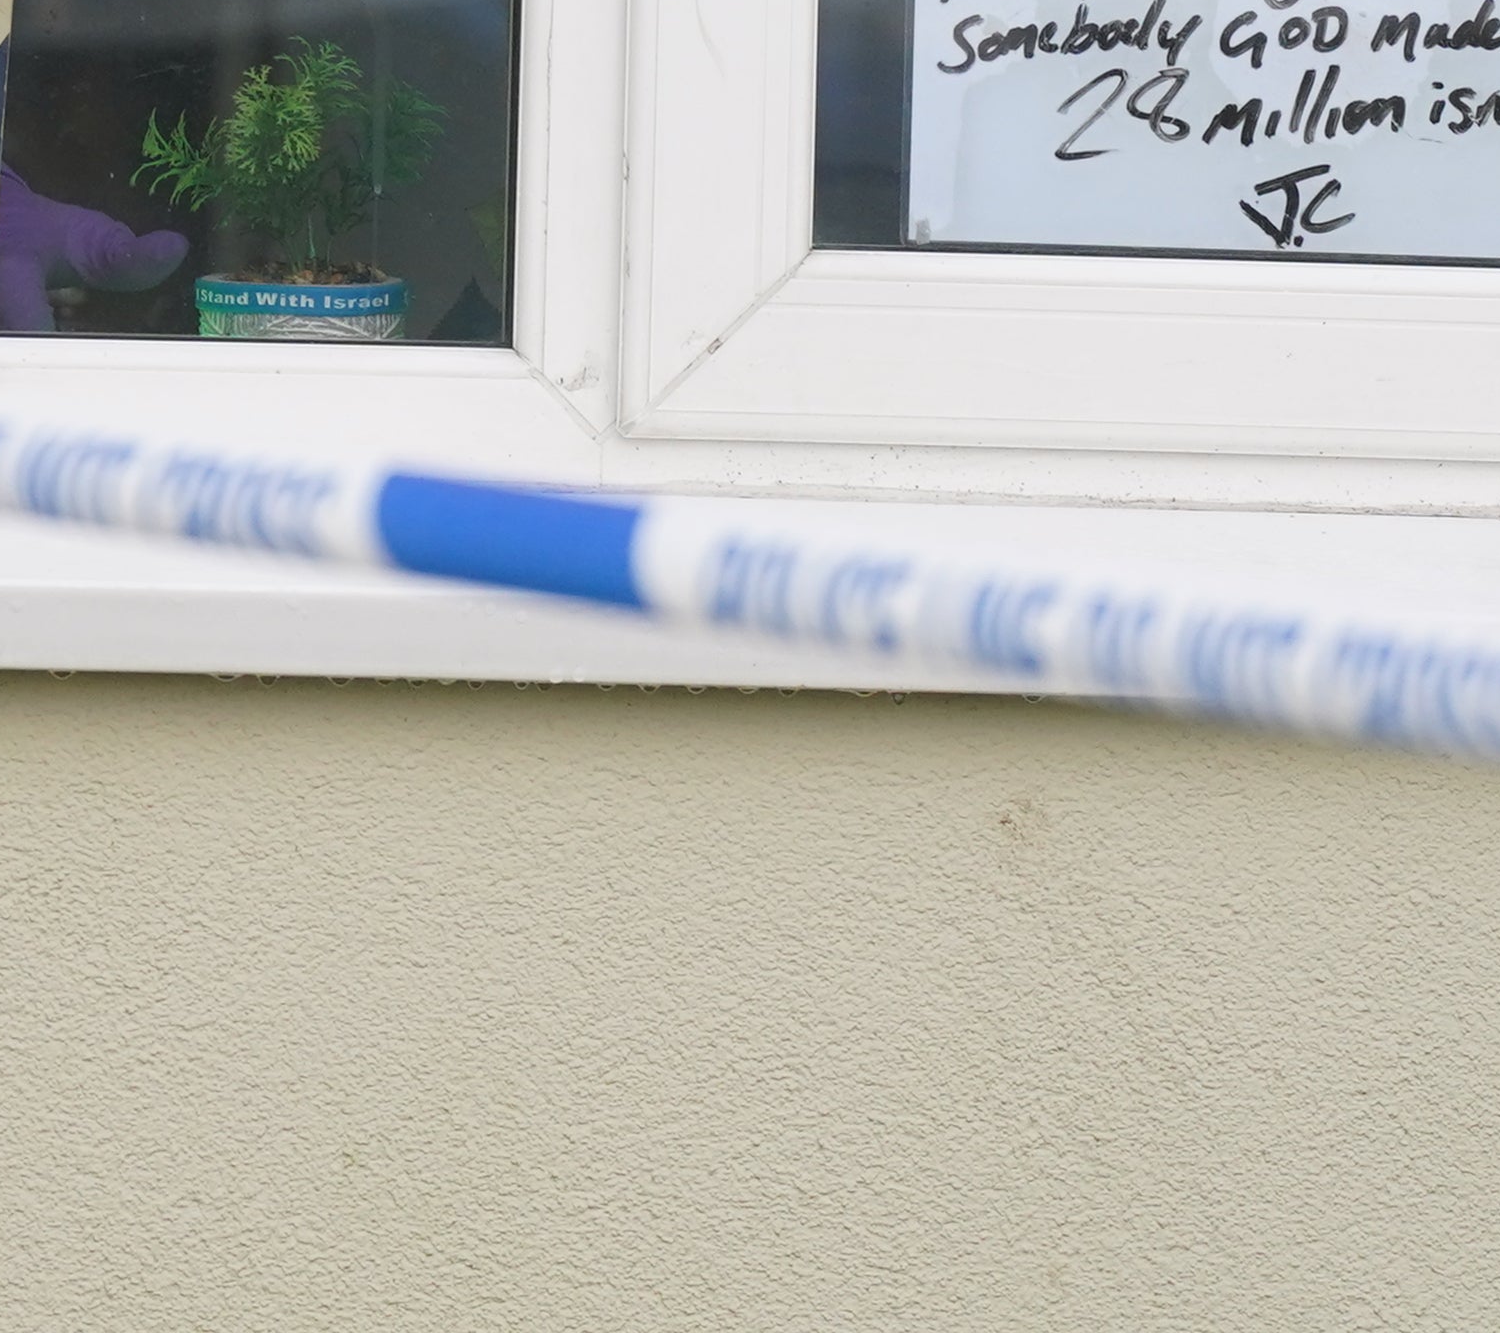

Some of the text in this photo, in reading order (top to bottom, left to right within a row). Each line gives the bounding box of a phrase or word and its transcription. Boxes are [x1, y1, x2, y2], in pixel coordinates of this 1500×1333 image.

[1055, 67, 1191, 160] 28
[200, 288, 249, 305] Stand
[255, 291, 315, 308] With
[324, 294, 389, 310] Israel
